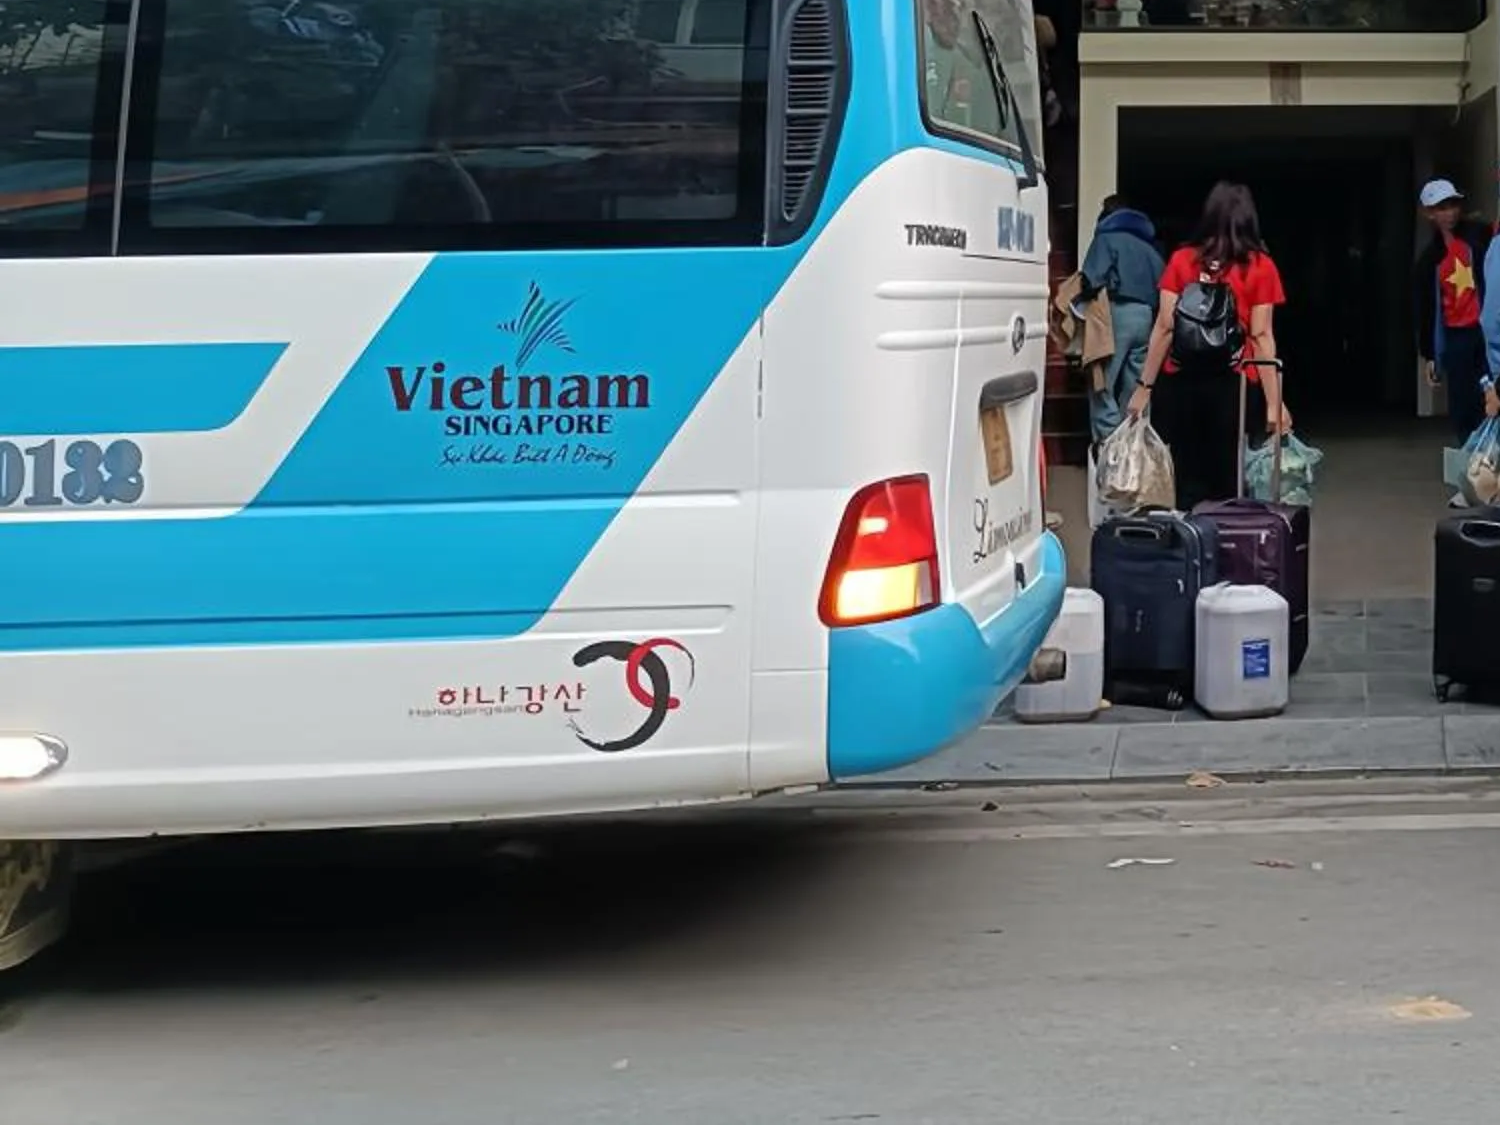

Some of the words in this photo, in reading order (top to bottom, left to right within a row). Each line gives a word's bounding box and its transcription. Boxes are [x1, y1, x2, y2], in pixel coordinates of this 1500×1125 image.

[386, 361, 649, 412] Vietnam
[444, 414, 613, 435] SINGAPORE
[437, 682, 587, 714] 하나강산
